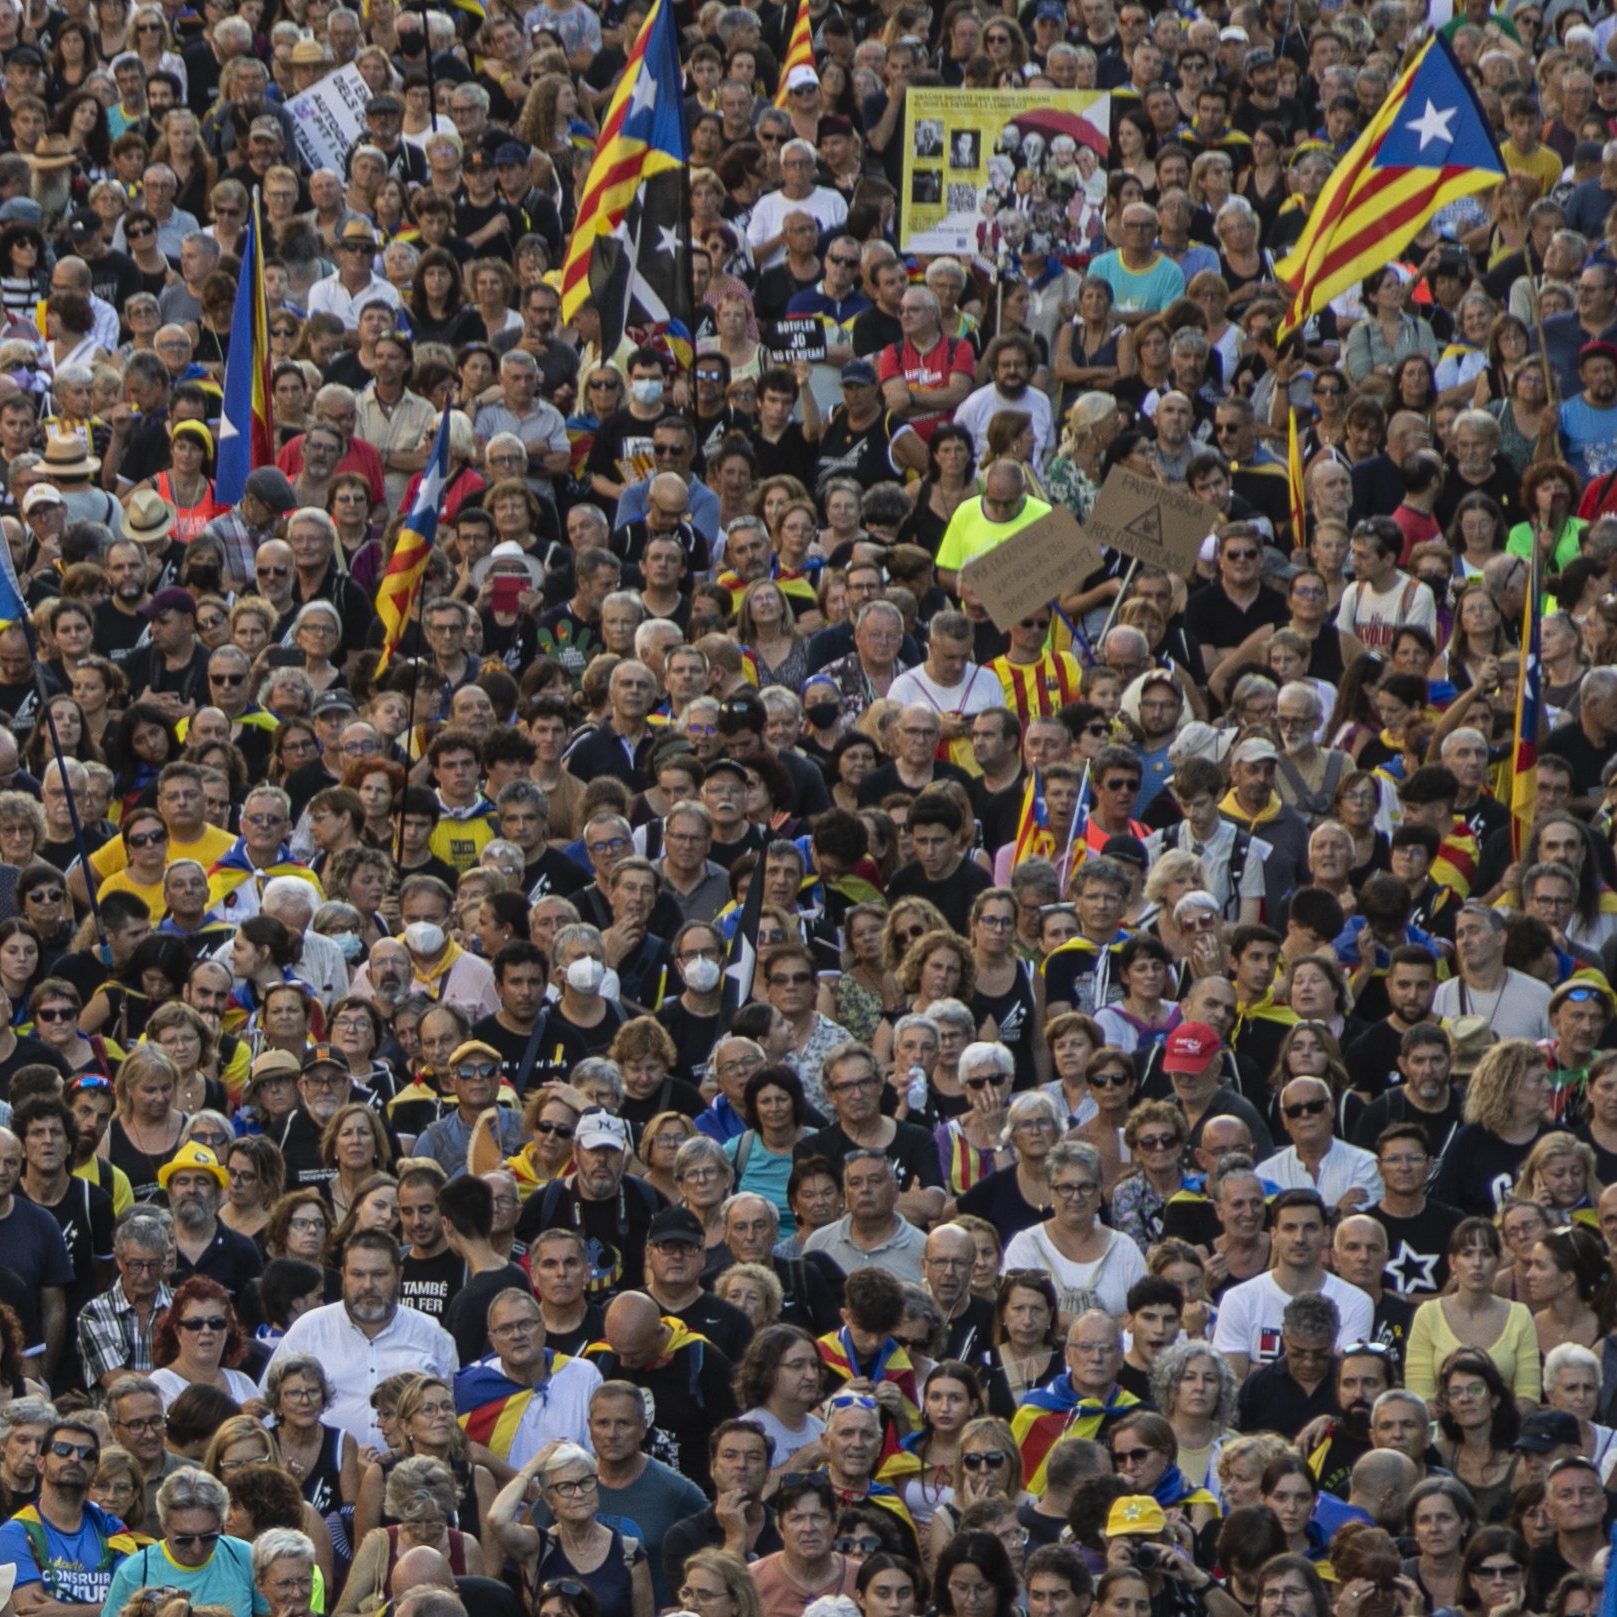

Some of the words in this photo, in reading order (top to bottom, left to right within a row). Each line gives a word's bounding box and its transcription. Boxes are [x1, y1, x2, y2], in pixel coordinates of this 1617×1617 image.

[791, 332, 806, 348] JO
[402, 1280, 448, 1297] TAMBÉ
[419, 1297, 443, 1313] FER
